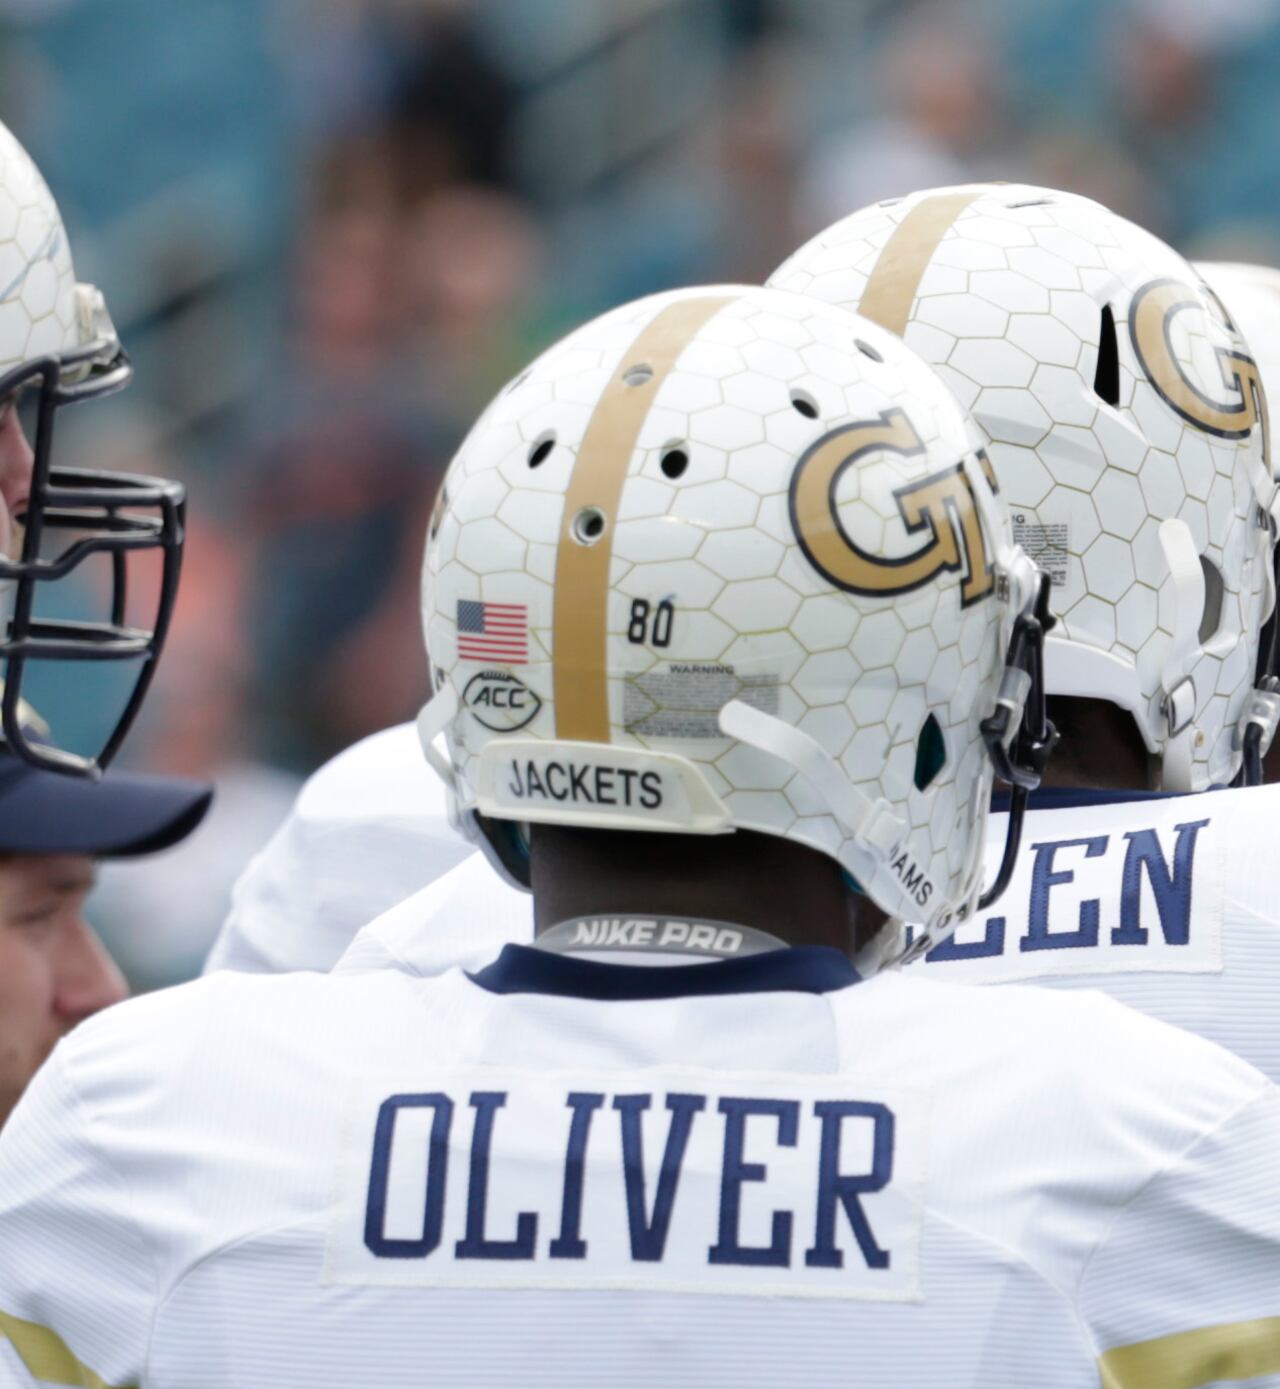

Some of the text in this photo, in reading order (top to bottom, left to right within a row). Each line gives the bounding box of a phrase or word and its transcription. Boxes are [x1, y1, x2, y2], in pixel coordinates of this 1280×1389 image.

[788, 406, 998, 610] GT
[628, 598, 674, 648] 80
[670, 664, 734, 675] WARNING
[473, 687, 527, 709] ACC
[509, 760, 663, 809] JACKETS
[569, 919, 743, 952] NIKE PRO
[363, 1091, 896, 1269] OLIVER
